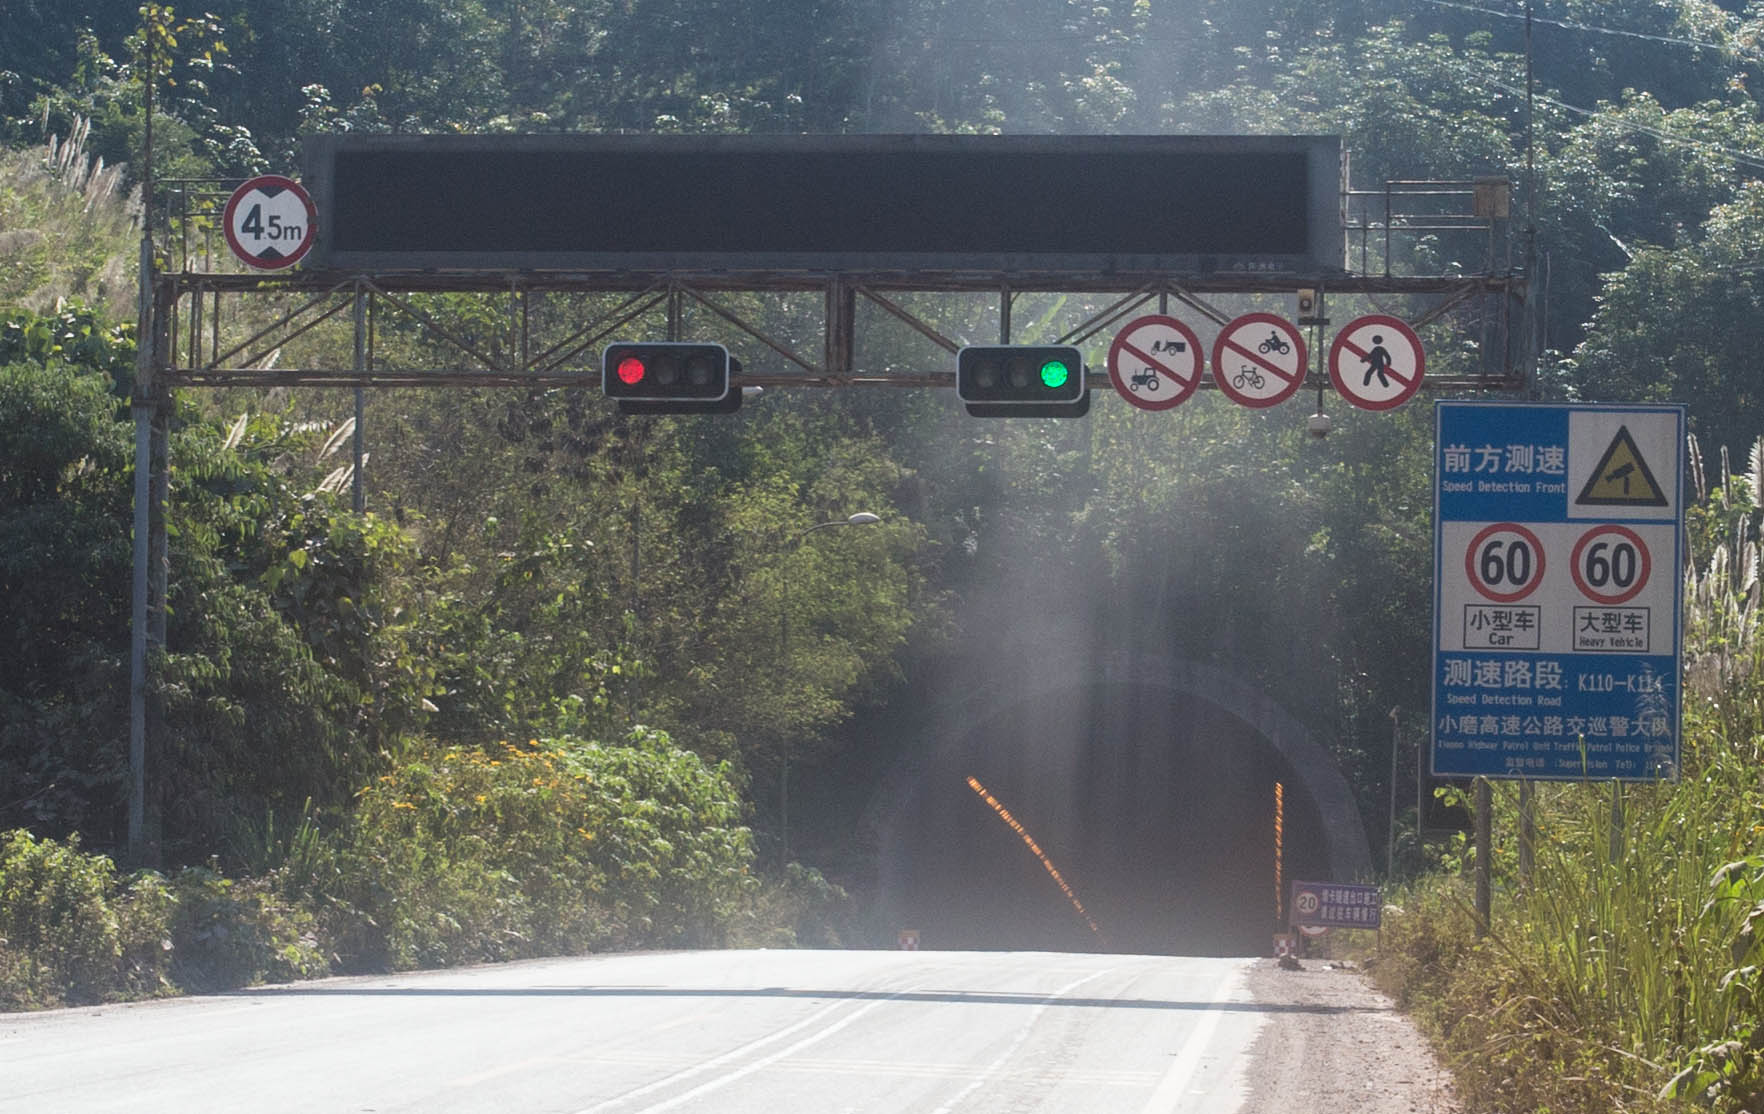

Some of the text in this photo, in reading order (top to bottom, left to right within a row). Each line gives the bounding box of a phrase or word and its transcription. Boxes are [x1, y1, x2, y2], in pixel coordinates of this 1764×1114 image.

[1443, 443, 1566, 475] 前方测速
[1442, 480, 1566, 493] Speed Detection Front
[1480, 540, 1531, 586] 60
[1585, 542, 1637, 588] 60
[1470, 610, 1535, 632] 小型车
[1579, 612, 1644, 634] 大型车
[1488, 632, 1514, 646] Car
[1579, 636, 1644, 649] Heavy Vehicle
[1447, 693, 1562, 707] Speed Detection Road
[1438, 714, 1672, 737] 小磨高速公路交巡警大队
[1299, 896, 1316, 910] 20
